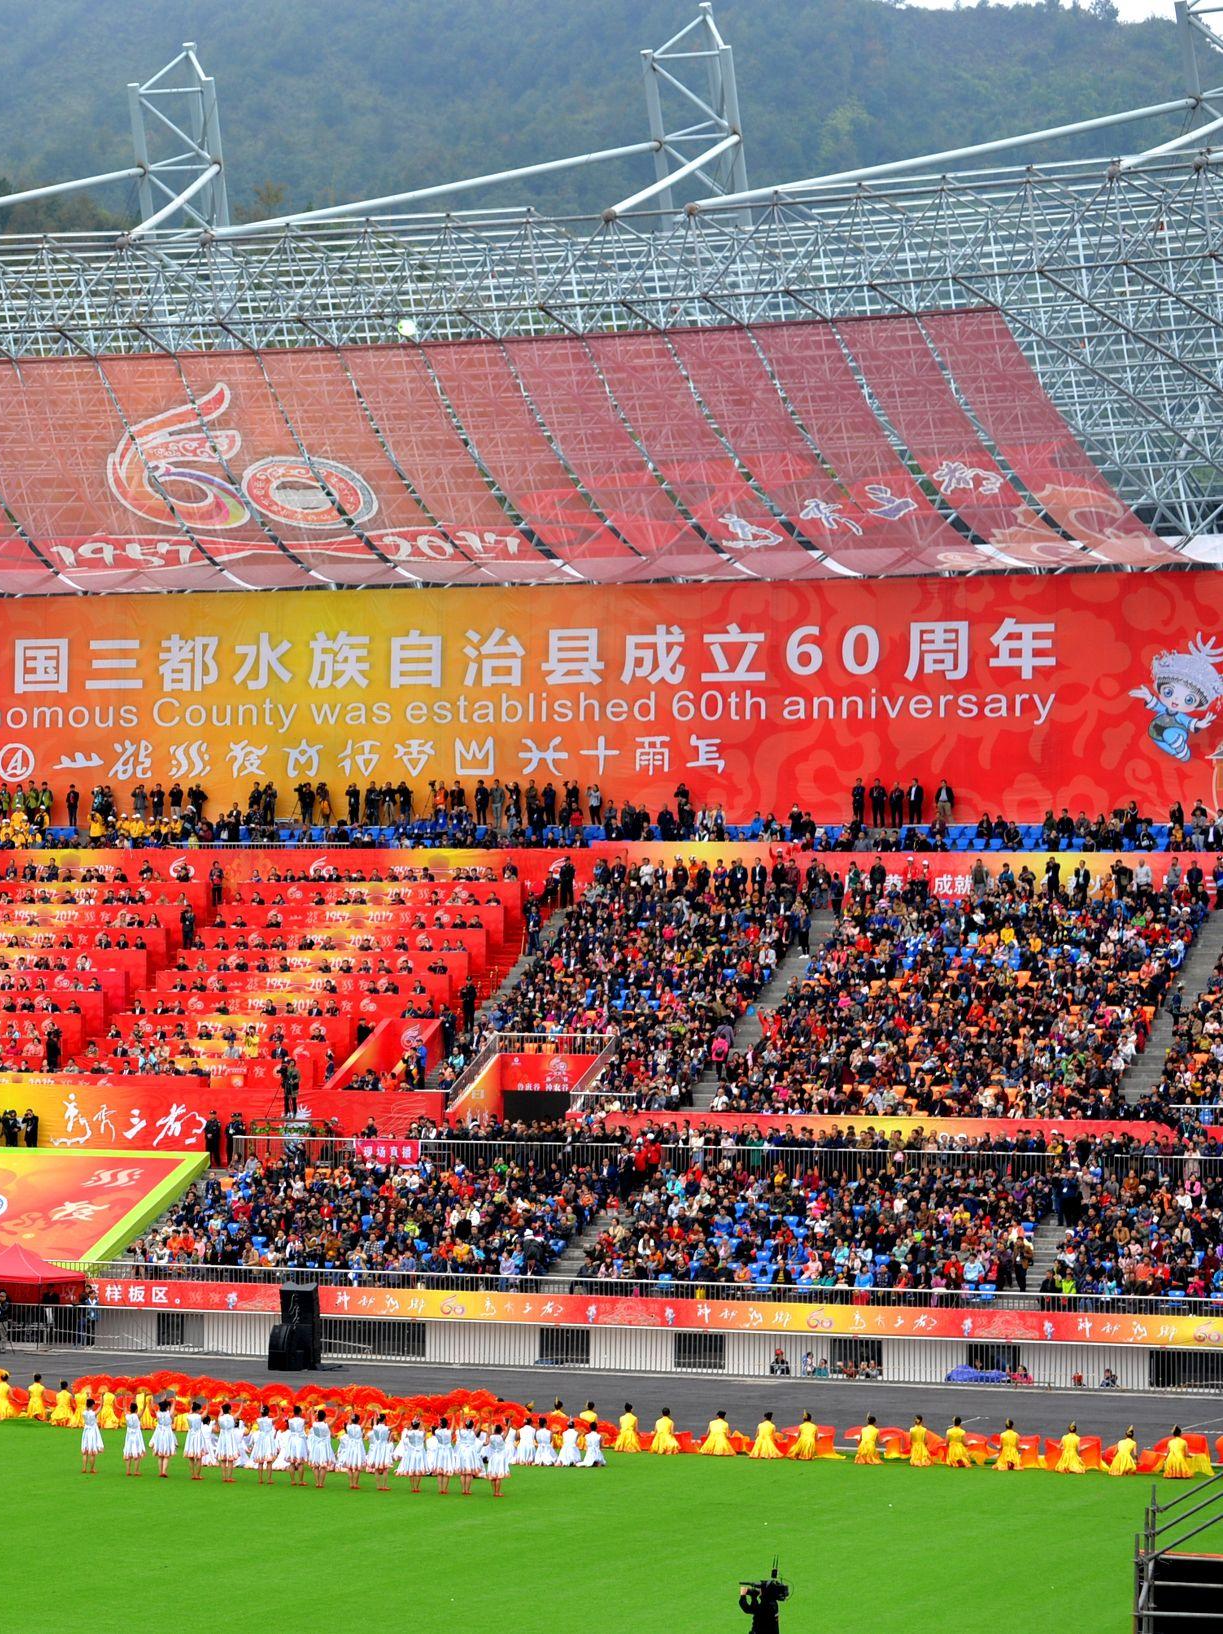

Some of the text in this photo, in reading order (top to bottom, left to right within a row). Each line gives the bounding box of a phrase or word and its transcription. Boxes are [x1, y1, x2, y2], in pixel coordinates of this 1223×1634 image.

[50, 530, 520, 570] 1957 2017
[152, 696, 298, 733] County
[310, 702, 393, 725] was
[405, 690, 656, 724] established
[672, 689, 766, 721] 60th
[782, 688, 1057, 726] anniversary
[55, 911, 79, 921] 2017
[325, 911, 350, 922] 1957
[368, 911, 393, 922] 2017
[286, 957, 310, 967] 1957
[55, 973, 69, 987] 60
[266, 978, 290, 988] 1957
[360, 997, 376, 1012] 60
[363, 1146, 412, 1159] 现场直播
